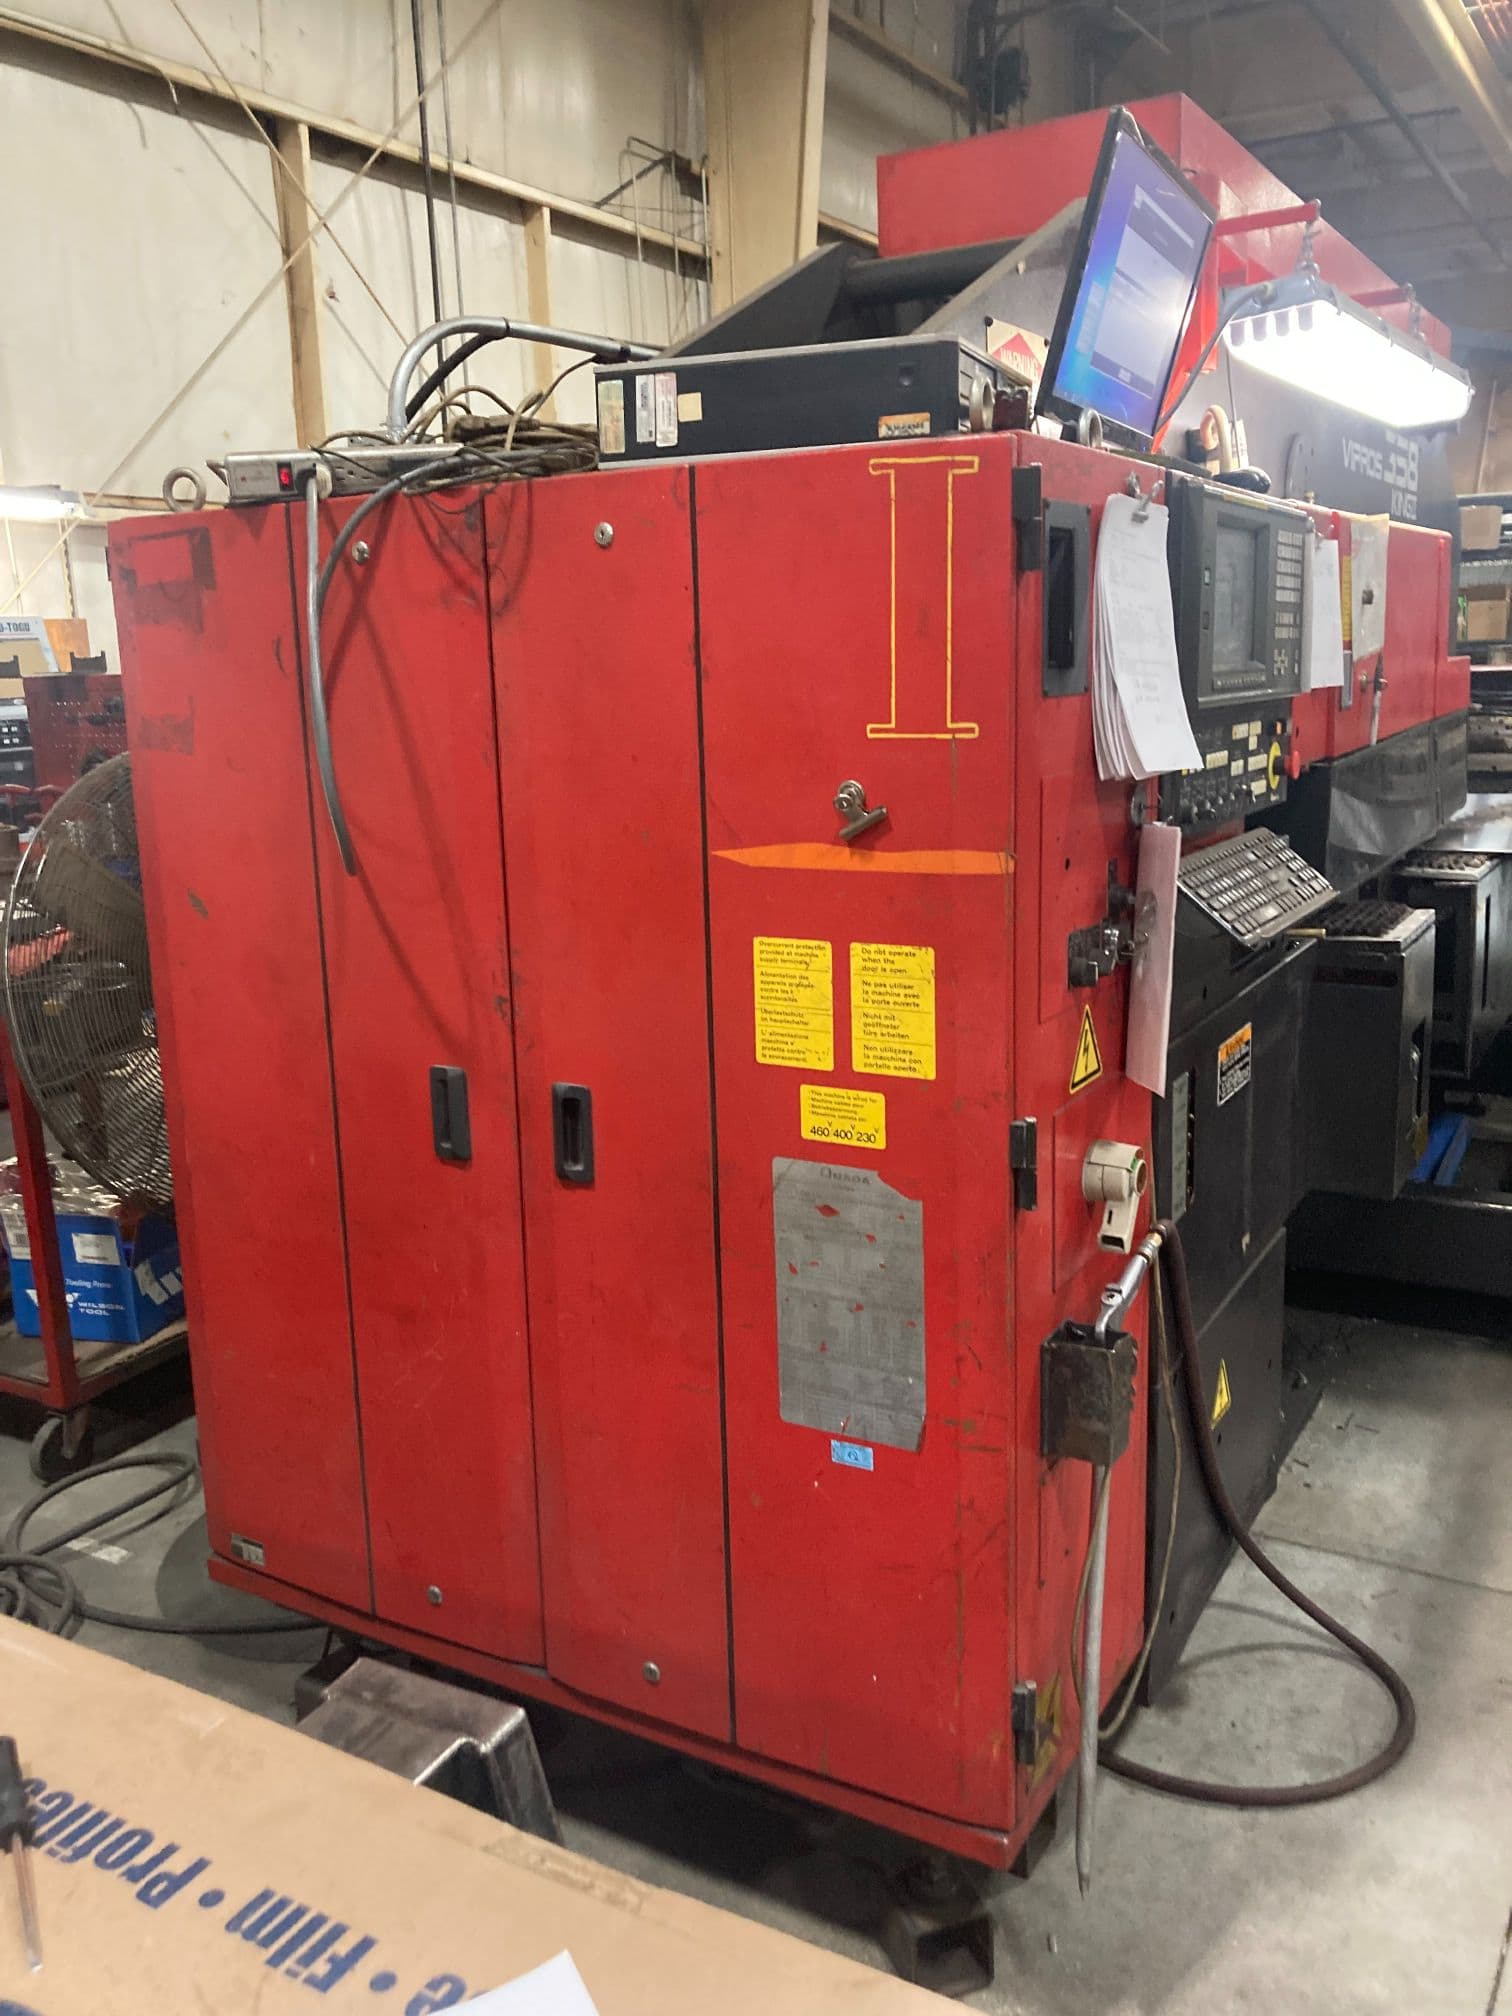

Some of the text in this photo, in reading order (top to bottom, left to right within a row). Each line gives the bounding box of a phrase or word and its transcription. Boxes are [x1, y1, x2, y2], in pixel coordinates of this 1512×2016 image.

[759, 940, 793, 948] Overcurrent
[861, 964, 877, 972] door
[760, 970, 796, 978] Alimentation
[889, 982, 913, 990] utiliser
[871, 989, 900, 997] machine
[862, 1011, 881, 1019] Nicht
[880, 1030, 909, 1039] arbeiten
[879, 1046, 912, 1055] utilizzare
[872, 1053, 905, 1063] macchina
[863, 1061, 890, 1070] portello
[810, 1125, 876, 1143] 460 400 230
[78, 1302, 125, 1310] WILSON
[80, 1308, 110, 1316] TOOL
[225, 1889, 378, 1995] Film
